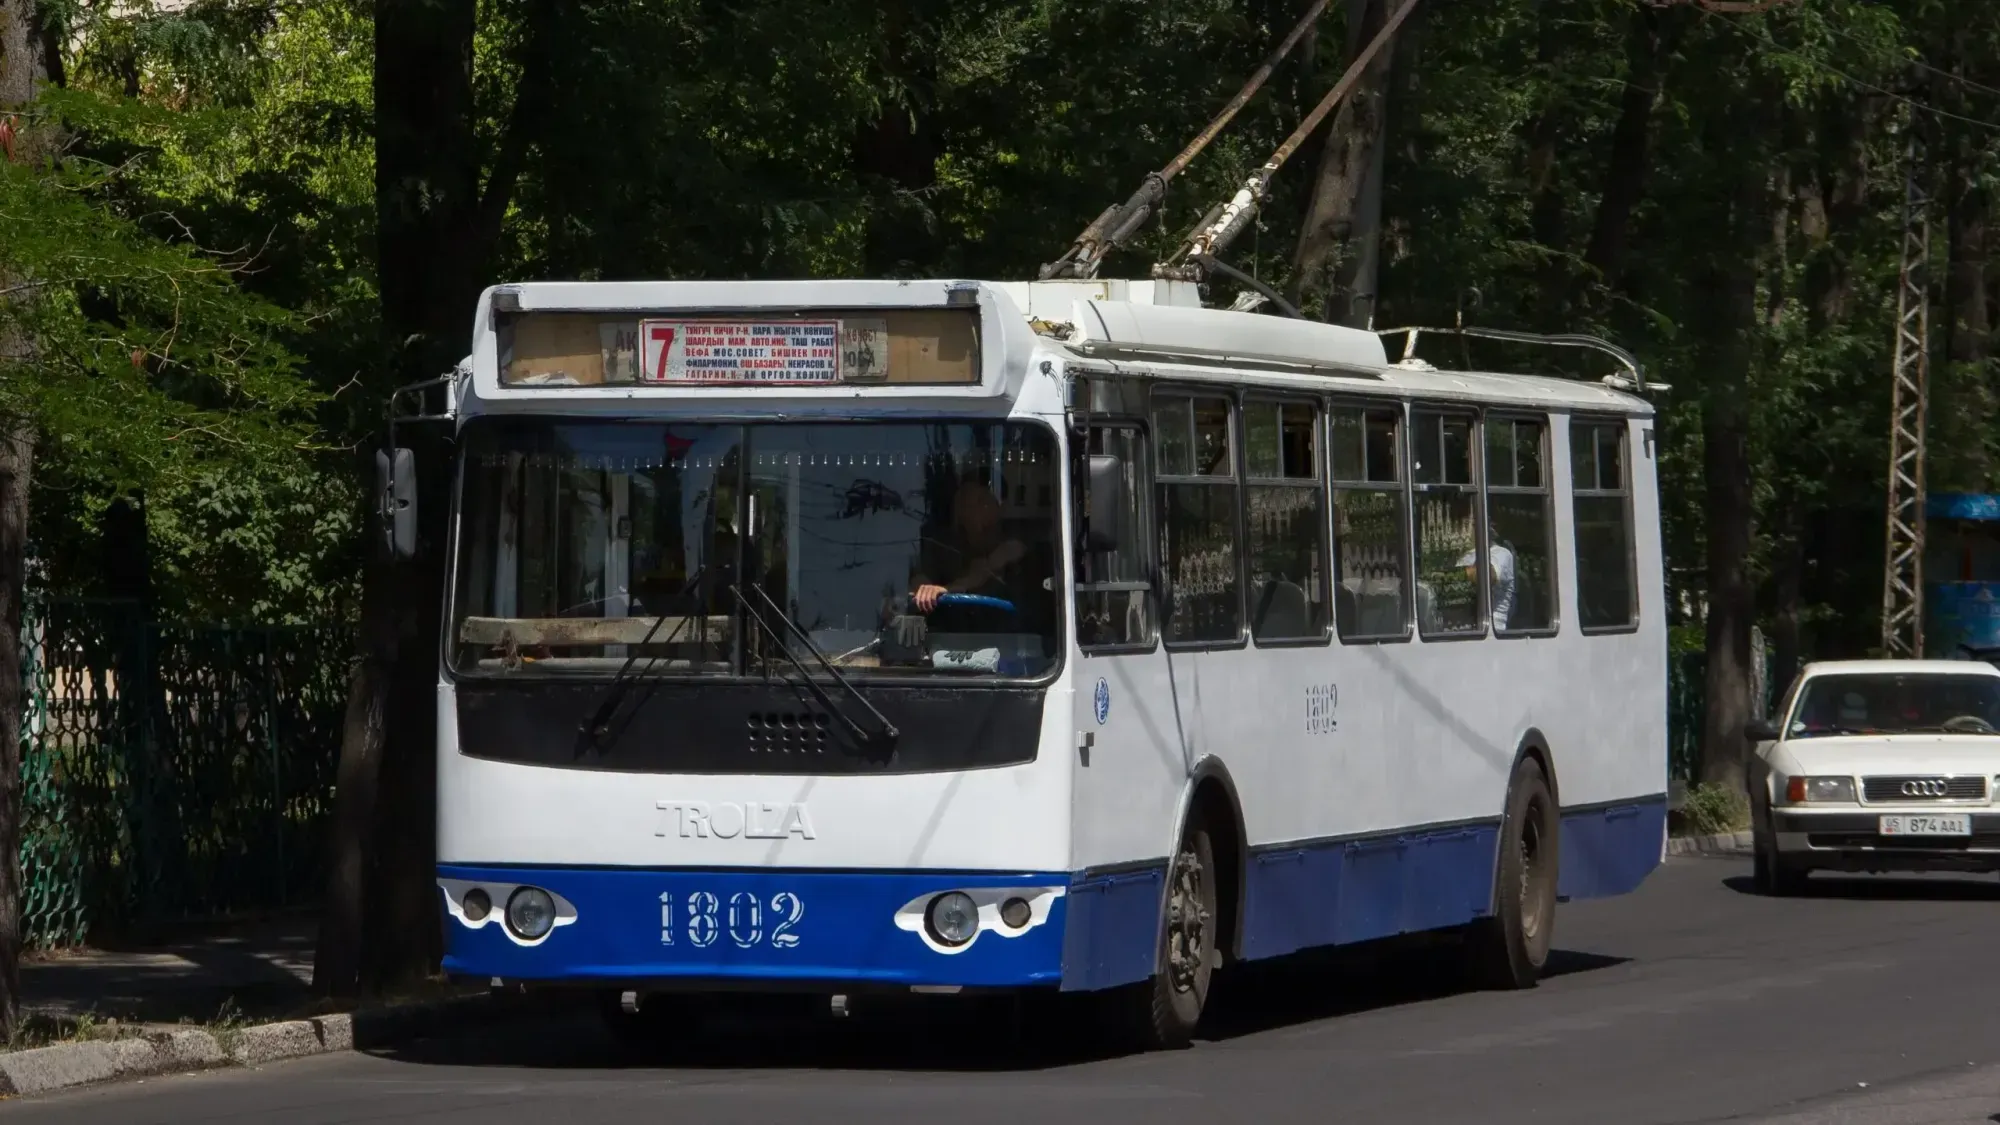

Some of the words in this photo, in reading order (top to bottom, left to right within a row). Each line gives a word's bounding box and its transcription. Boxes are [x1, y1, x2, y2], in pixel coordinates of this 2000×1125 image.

[752, 327, 771, 336] КАРА
[774, 327, 801, 336] ЖЫГАЧ
[792, 337, 808, 347] ТАШ
[811, 337, 834, 347] РАБАТ
[652, 328, 675, 379] 7
[685, 348, 710, 357] ВЕФА
[771, 348, 808, 358] БИШКЕК
[812, 348, 834, 358] ПАРК
[788, 359, 825, 369] НЕКРАСОВ
[744, 370, 756, 379] АК
[654, 800, 816, 841] TROLZA
[1909, 818, 1938, 833] 874
[658, 890, 805, 949] 1802
